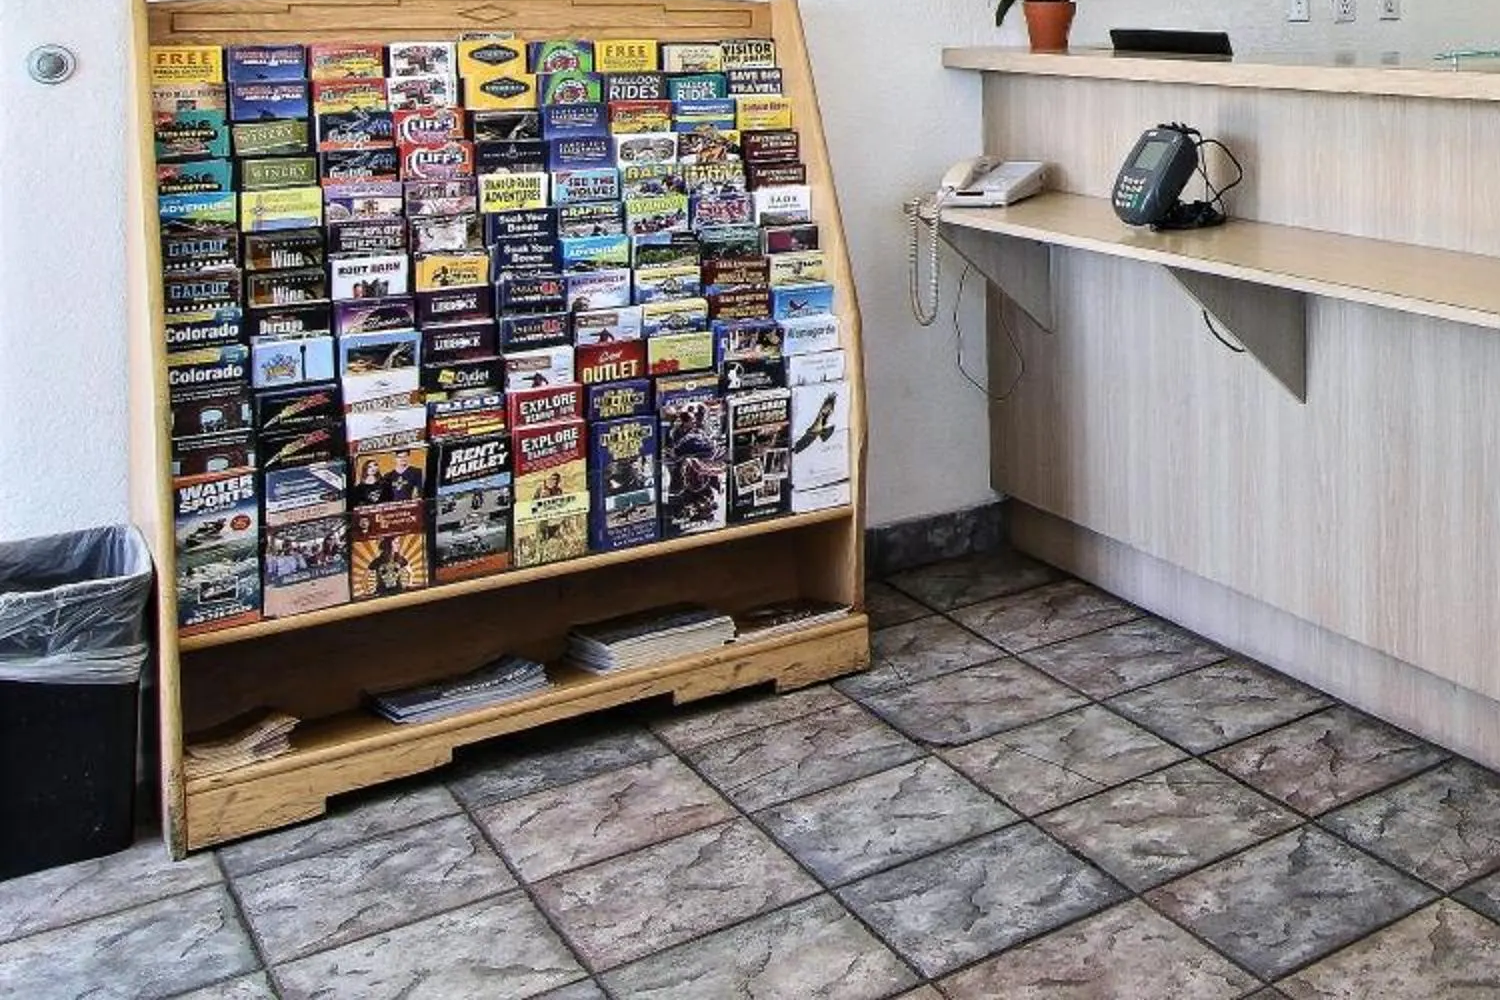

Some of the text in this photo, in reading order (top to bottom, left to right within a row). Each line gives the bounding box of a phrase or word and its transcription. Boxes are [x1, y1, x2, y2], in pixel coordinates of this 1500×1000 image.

[605, 46, 646, 58] FREE
[721, 43, 772, 56] VISITOR
[157, 53, 211, 65] FREE
[609, 75, 660, 85] BALLOON
[730, 71, 756, 81] SAVE
[609, 85, 659, 100] RIDES
[677, 88, 717, 101] RIDES
[252, 166, 306, 179] WINERY
[592, 176, 615, 185] THE
[567, 186, 615, 197] WOLVES
[525, 213, 548, 222] Your
[569, 206, 618, 217] RAFTING
[531, 244, 554, 252] Your
[271, 250, 304, 268] Wine
[338, 261, 400, 275] BOOT BARN
[171, 281, 229, 299] GALLUP
[272, 286, 305, 303] Wine
[166, 322, 239, 344] Colorado
[169, 364, 243, 385] Colorado
[583, 359, 639, 384] OUTLET
[519, 392, 577, 416] EXPLORE
[521, 428, 580, 454] EXPLORE
[180, 475, 254, 501] WATER
[179, 489, 254, 514] SPORTS
